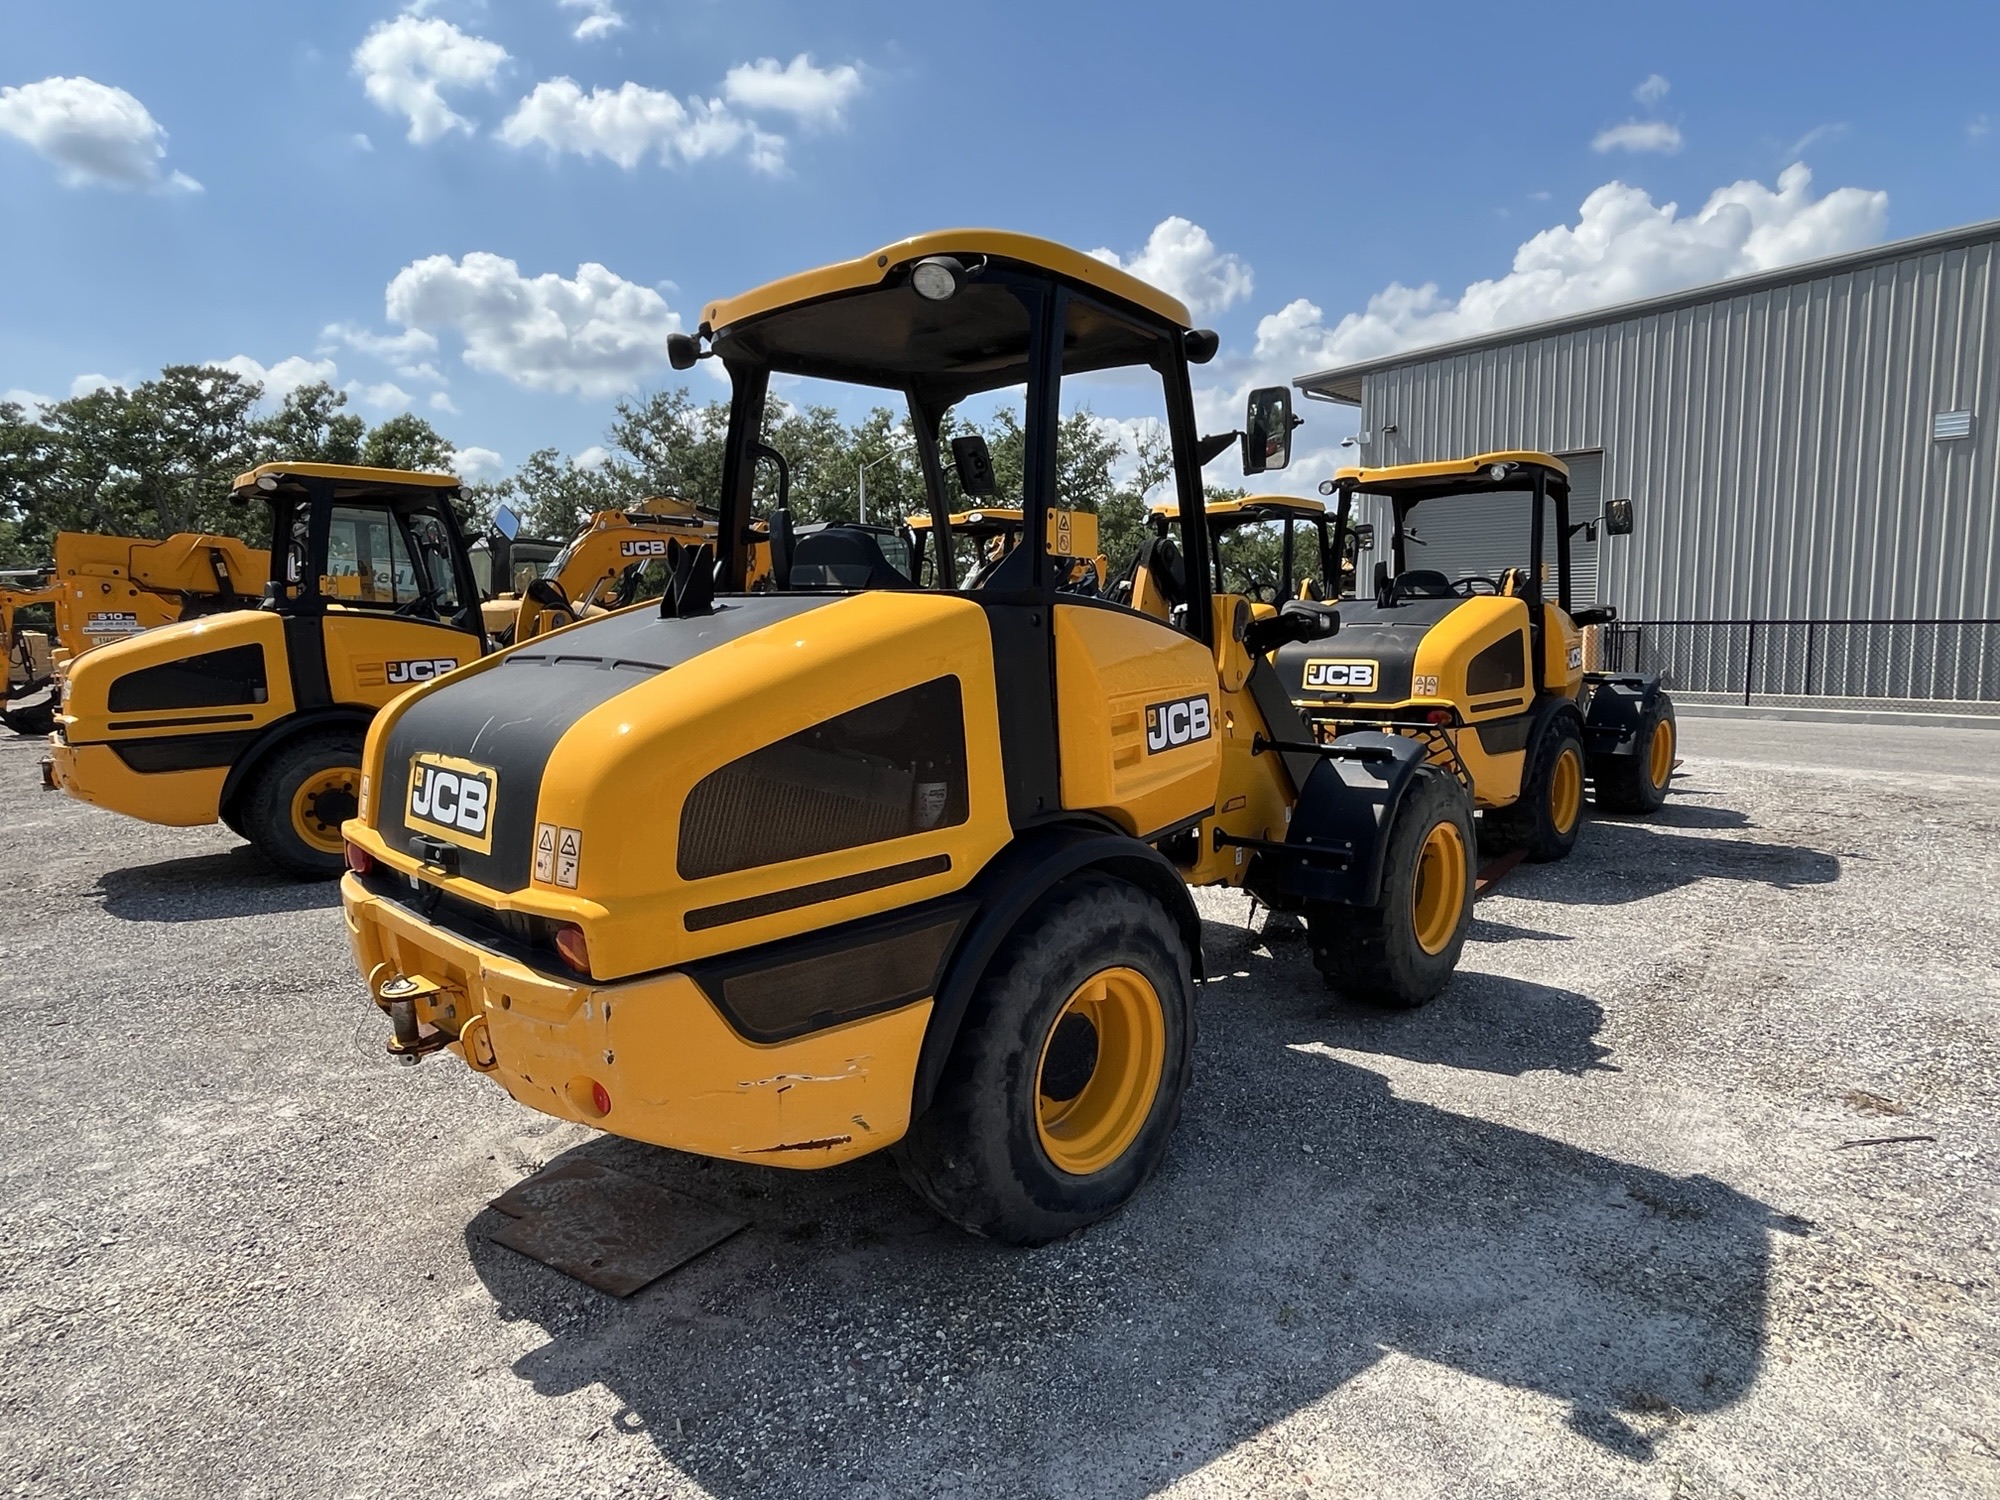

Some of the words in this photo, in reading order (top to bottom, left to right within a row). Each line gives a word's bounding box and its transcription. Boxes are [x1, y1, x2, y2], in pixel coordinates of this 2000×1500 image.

[622, 541, 666, 556] JCB
[389, 659, 456, 682] JCB
[1308, 665, 1372, 685] JCB
[1148, 698, 1210, 750] JCB
[413, 769, 488, 832] JCB
